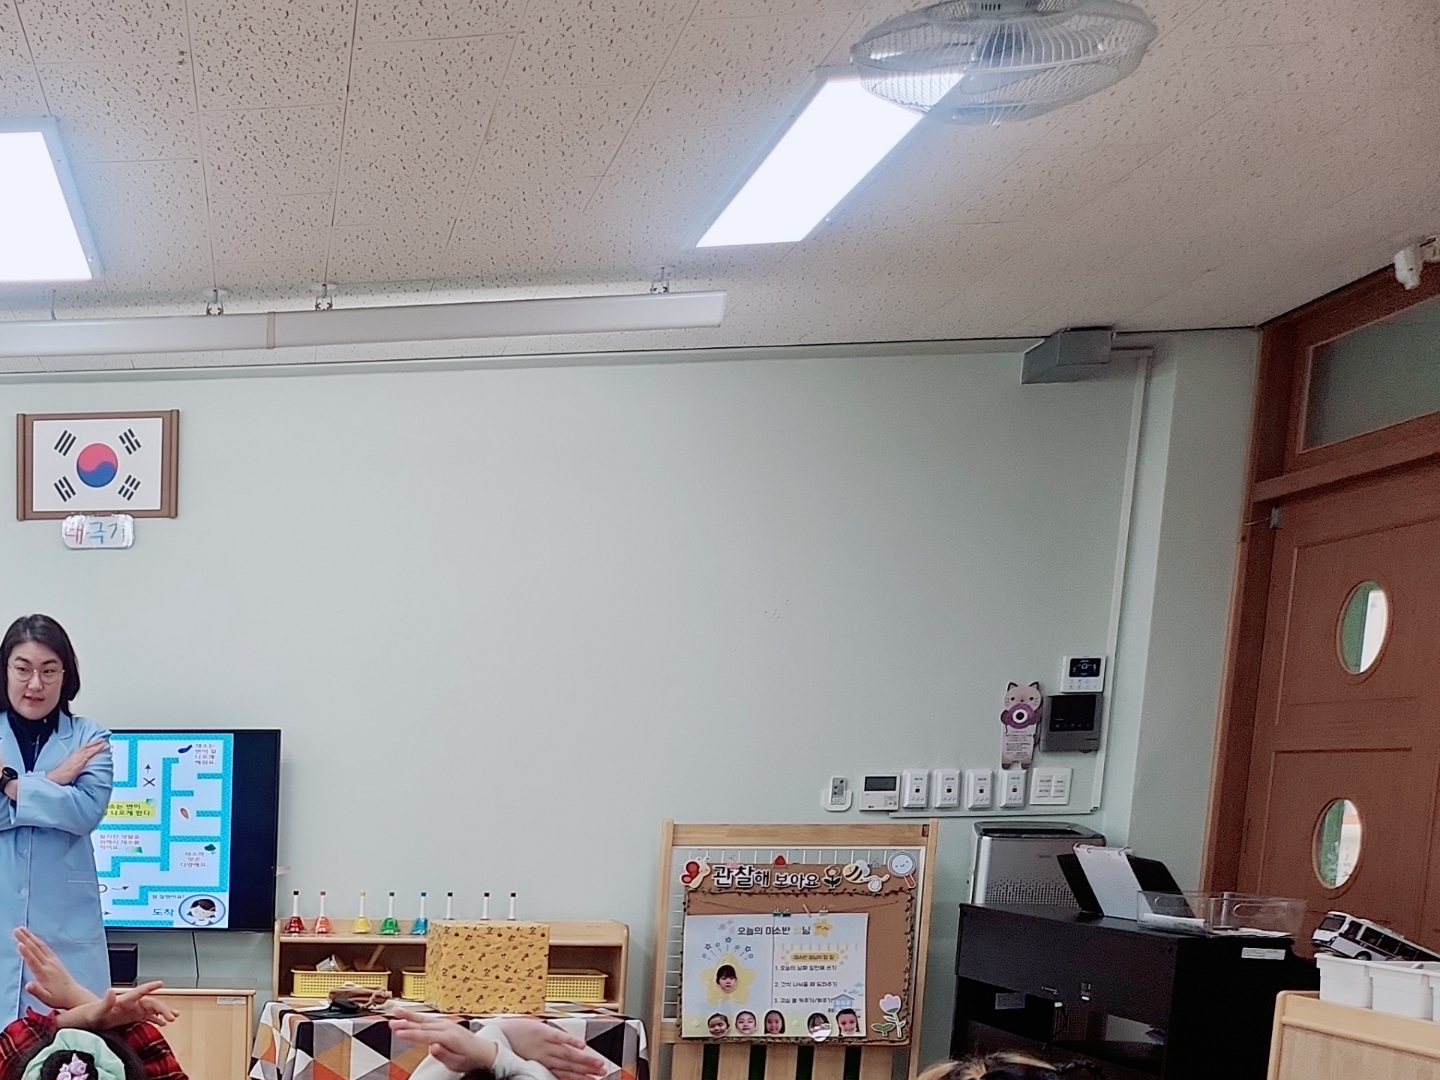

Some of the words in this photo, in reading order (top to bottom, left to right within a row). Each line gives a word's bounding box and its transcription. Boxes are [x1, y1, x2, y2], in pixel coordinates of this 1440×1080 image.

[712, 865, 770, 889] 관찰해
[773, 872, 820, 889] 보아요
[152, 908, 175, 917] 도착
[737, 926, 763, 936] 오늘의
[765, 926, 791, 936] 미소반
